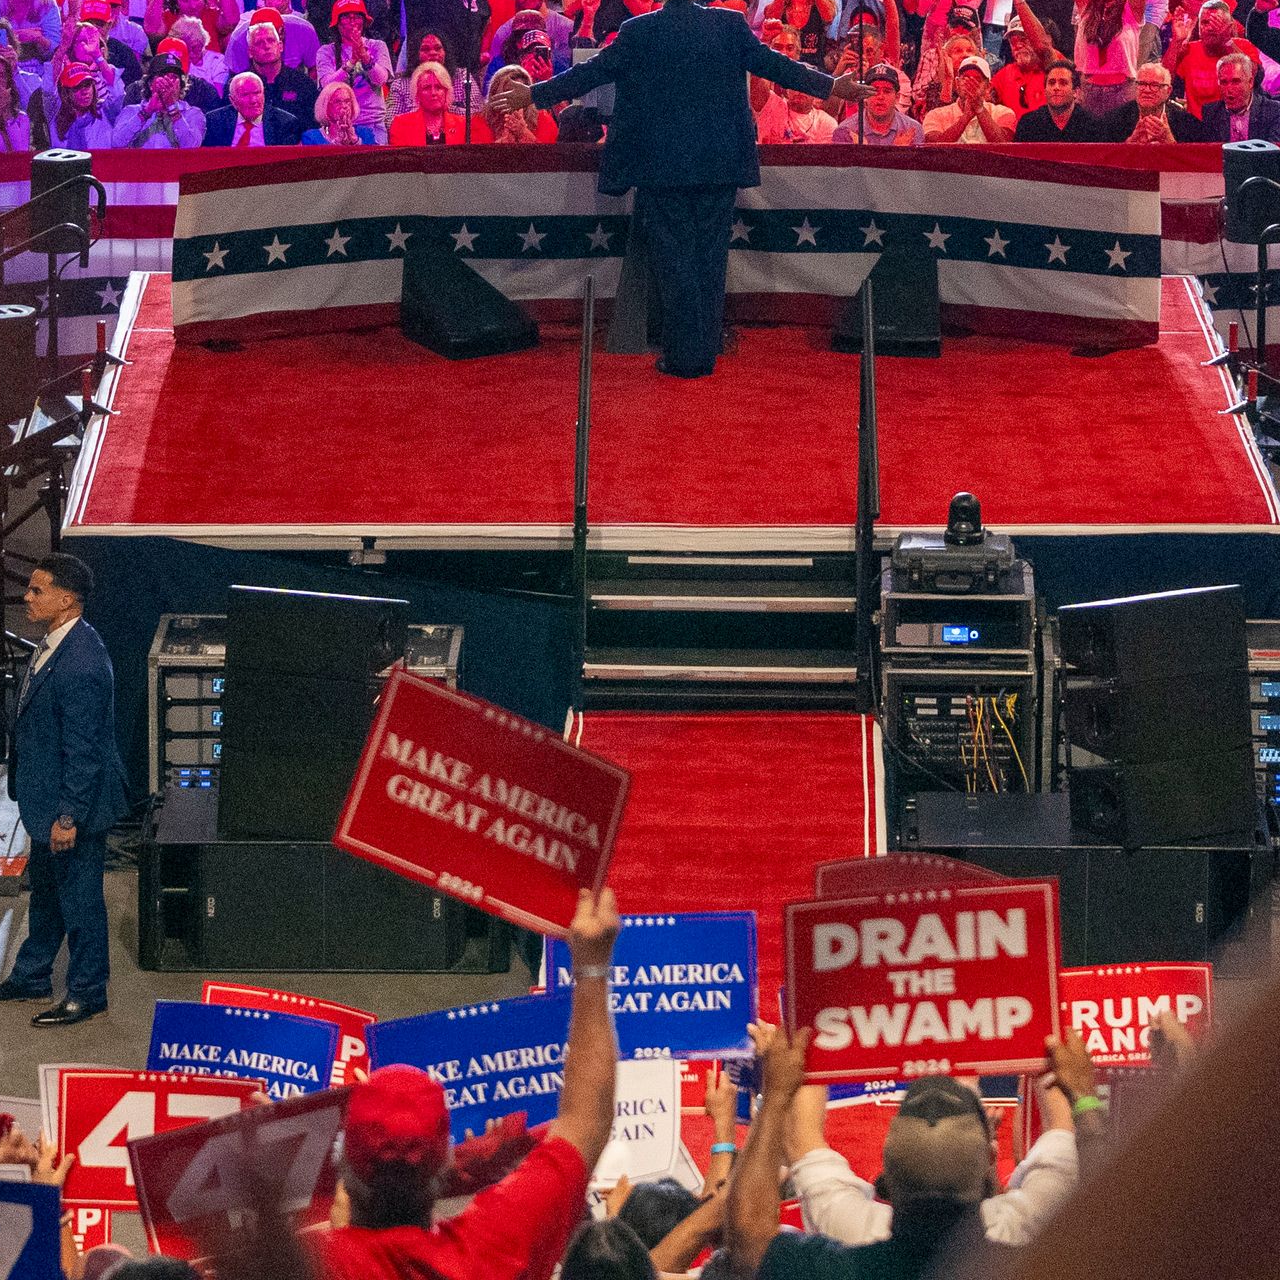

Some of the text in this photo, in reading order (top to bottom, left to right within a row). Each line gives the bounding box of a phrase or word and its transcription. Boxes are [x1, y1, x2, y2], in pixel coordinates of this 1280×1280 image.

[381, 731, 599, 849] MAKE AMERICA
[386, 773, 581, 873] GREAT AGAIN
[812, 908, 1027, 973] DRAIN
[633, 963, 744, 985] AMERICA
[889, 968, 956, 997] THE
[609, 990, 732, 1013] EAT AGAIN
[1062, 994, 1203, 1030] RUMP
[814, 996, 1034, 1051] SWAMP
[159, 1042, 221, 1062] MAKE
[225, 1048, 320, 1081] AMERICA
[634, 1047, 671, 1059] 2024
[901, 1058, 952, 1076] 2024
[445, 1082, 488, 1109] EAT
[617, 1099, 668, 1117] RICA
